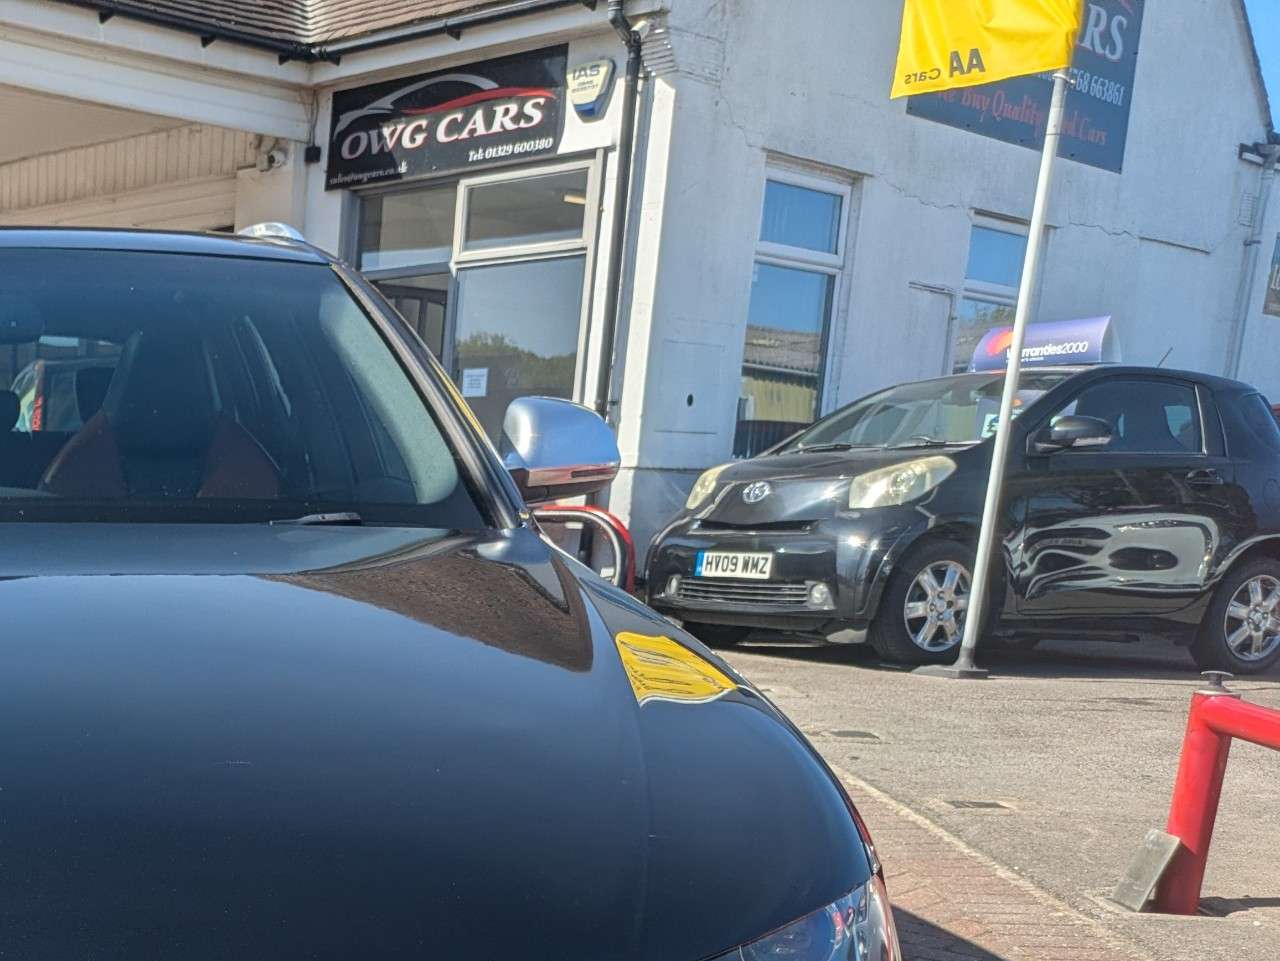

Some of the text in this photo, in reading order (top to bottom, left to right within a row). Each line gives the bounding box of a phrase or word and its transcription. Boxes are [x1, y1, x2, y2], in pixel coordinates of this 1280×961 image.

[1076, 3, 1127, 61] RS
[340, 97, 546, 160] OWG CARS
[485, 145, 513, 159] 01329
[704, 554, 770, 575] HV09 WMZ
